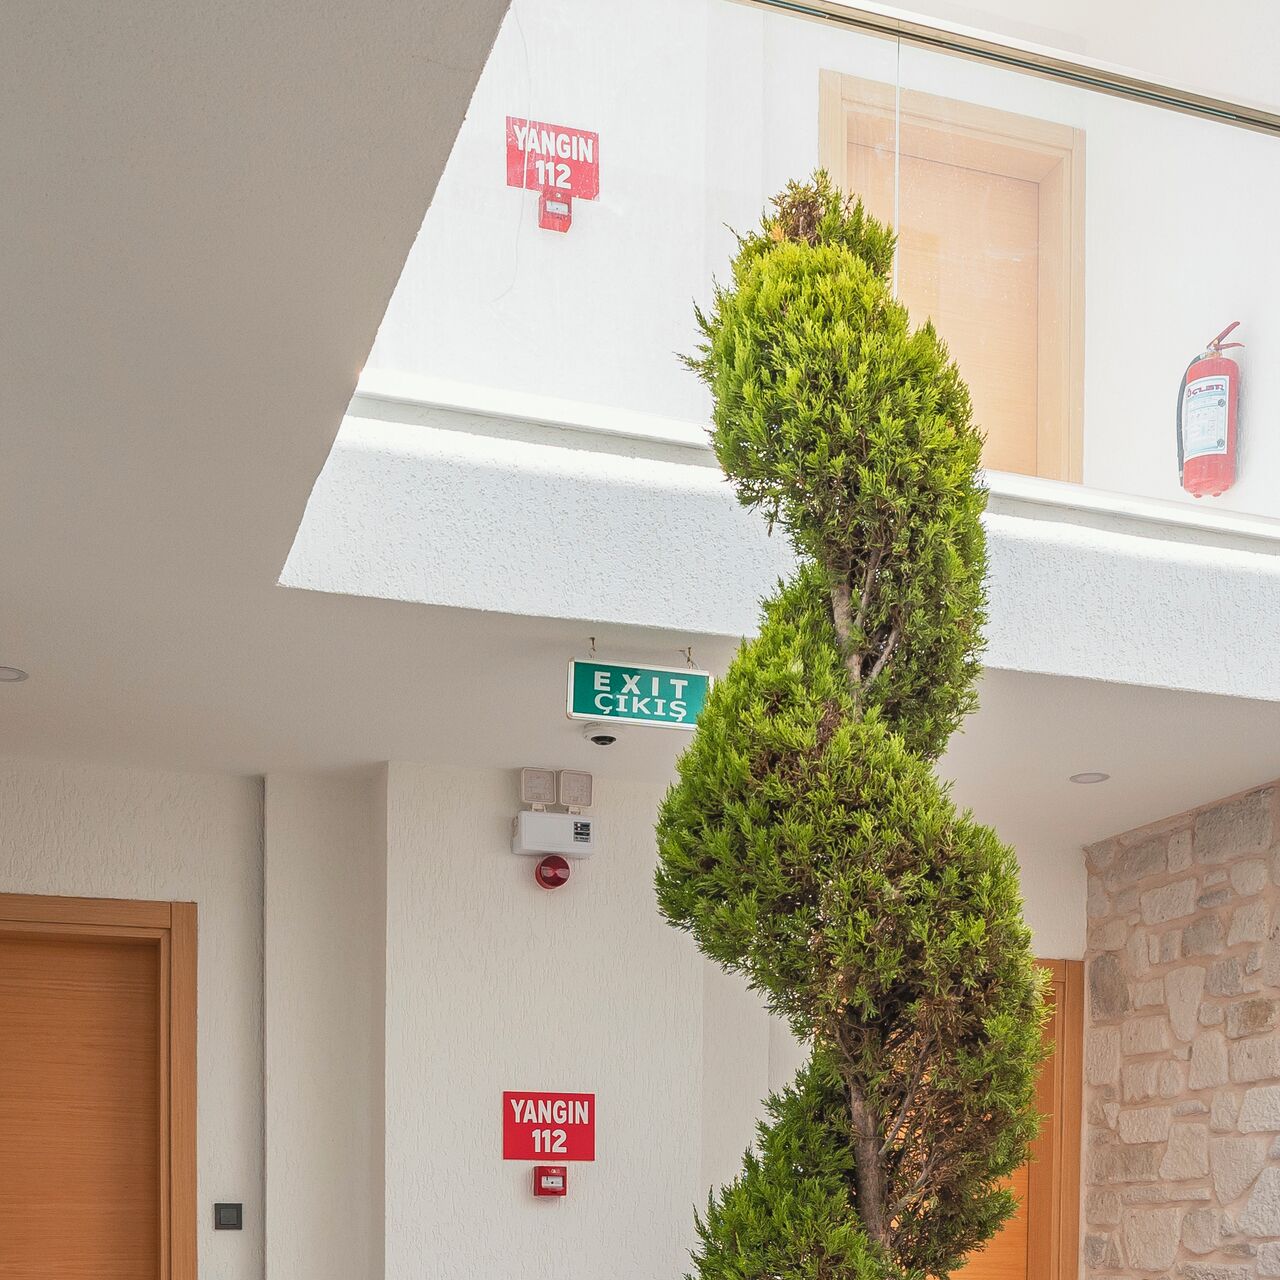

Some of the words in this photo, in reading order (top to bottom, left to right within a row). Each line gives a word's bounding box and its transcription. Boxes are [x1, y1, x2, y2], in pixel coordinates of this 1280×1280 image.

[513, 125, 593, 163] YANGIN
[535, 160, 572, 189] 112
[593, 671, 689, 699] EXIT
[594, 693, 687, 722] ÇIKIŞ
[510, 1099, 589, 1125] YANGIN
[531, 1129, 568, 1153] 112
